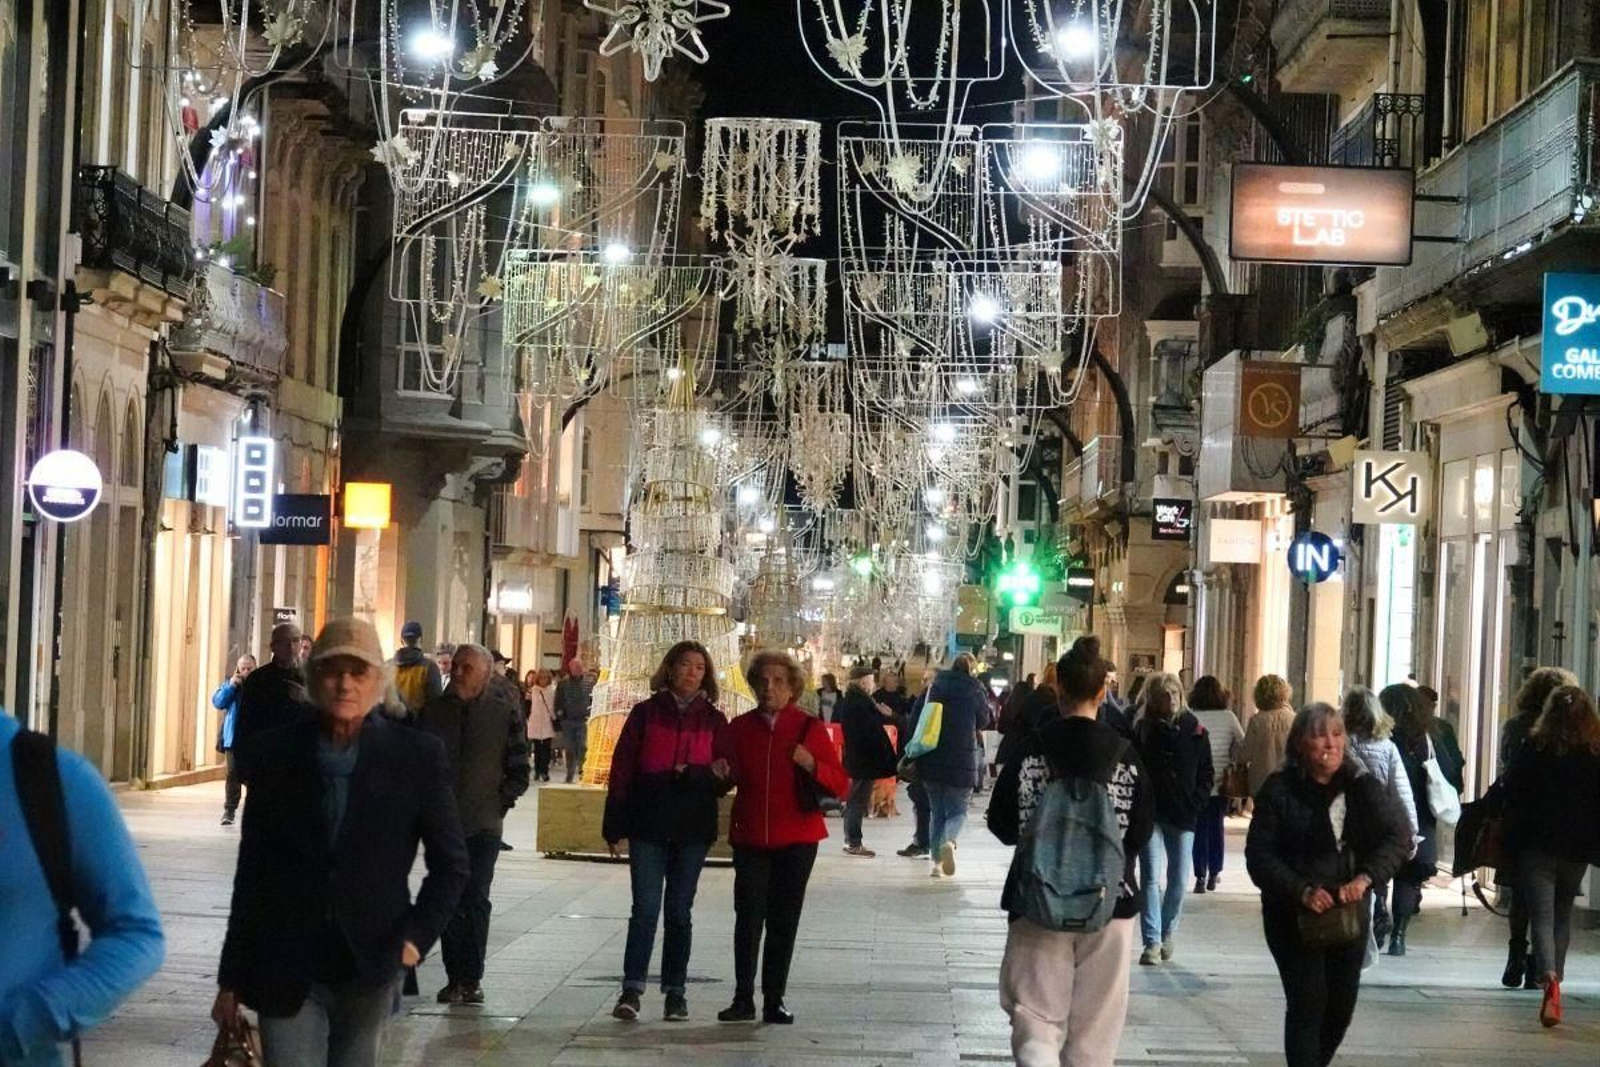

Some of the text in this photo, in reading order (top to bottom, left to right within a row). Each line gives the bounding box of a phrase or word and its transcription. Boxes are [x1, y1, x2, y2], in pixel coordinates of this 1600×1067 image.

[1293, 227, 1346, 247] LAB
[1156, 505, 1179, 514] Work
[271, 511, 323, 528] lormar
[1296, 543, 1330, 572] IN
